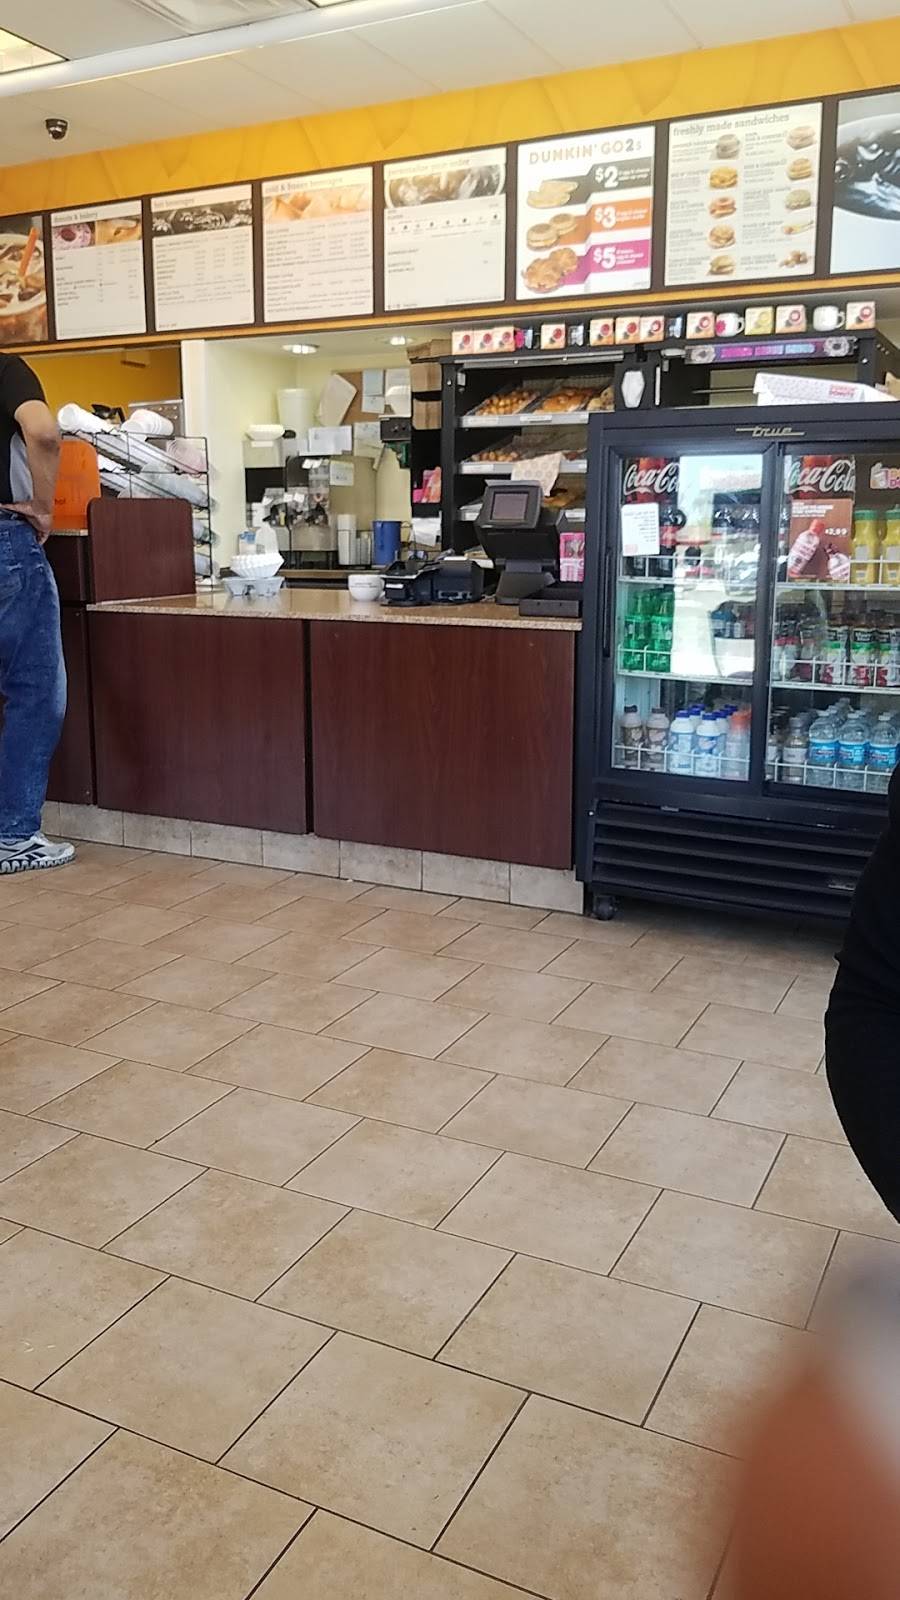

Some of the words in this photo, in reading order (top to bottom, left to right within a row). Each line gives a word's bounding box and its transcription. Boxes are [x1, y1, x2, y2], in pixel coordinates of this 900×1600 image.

[673, 123, 704, 136] freshly
[706, 120, 732, 132] made
[734, 113, 790, 129] sandwiches
[529, 144, 598, 165] DUNKIN'
[595, 165, 619, 188] $2
[594, 206, 616, 229] $3
[593, 245, 617, 270] $5
[736, 425, 805, 438] true
[786, 459, 855, 494] Coca-Cola
